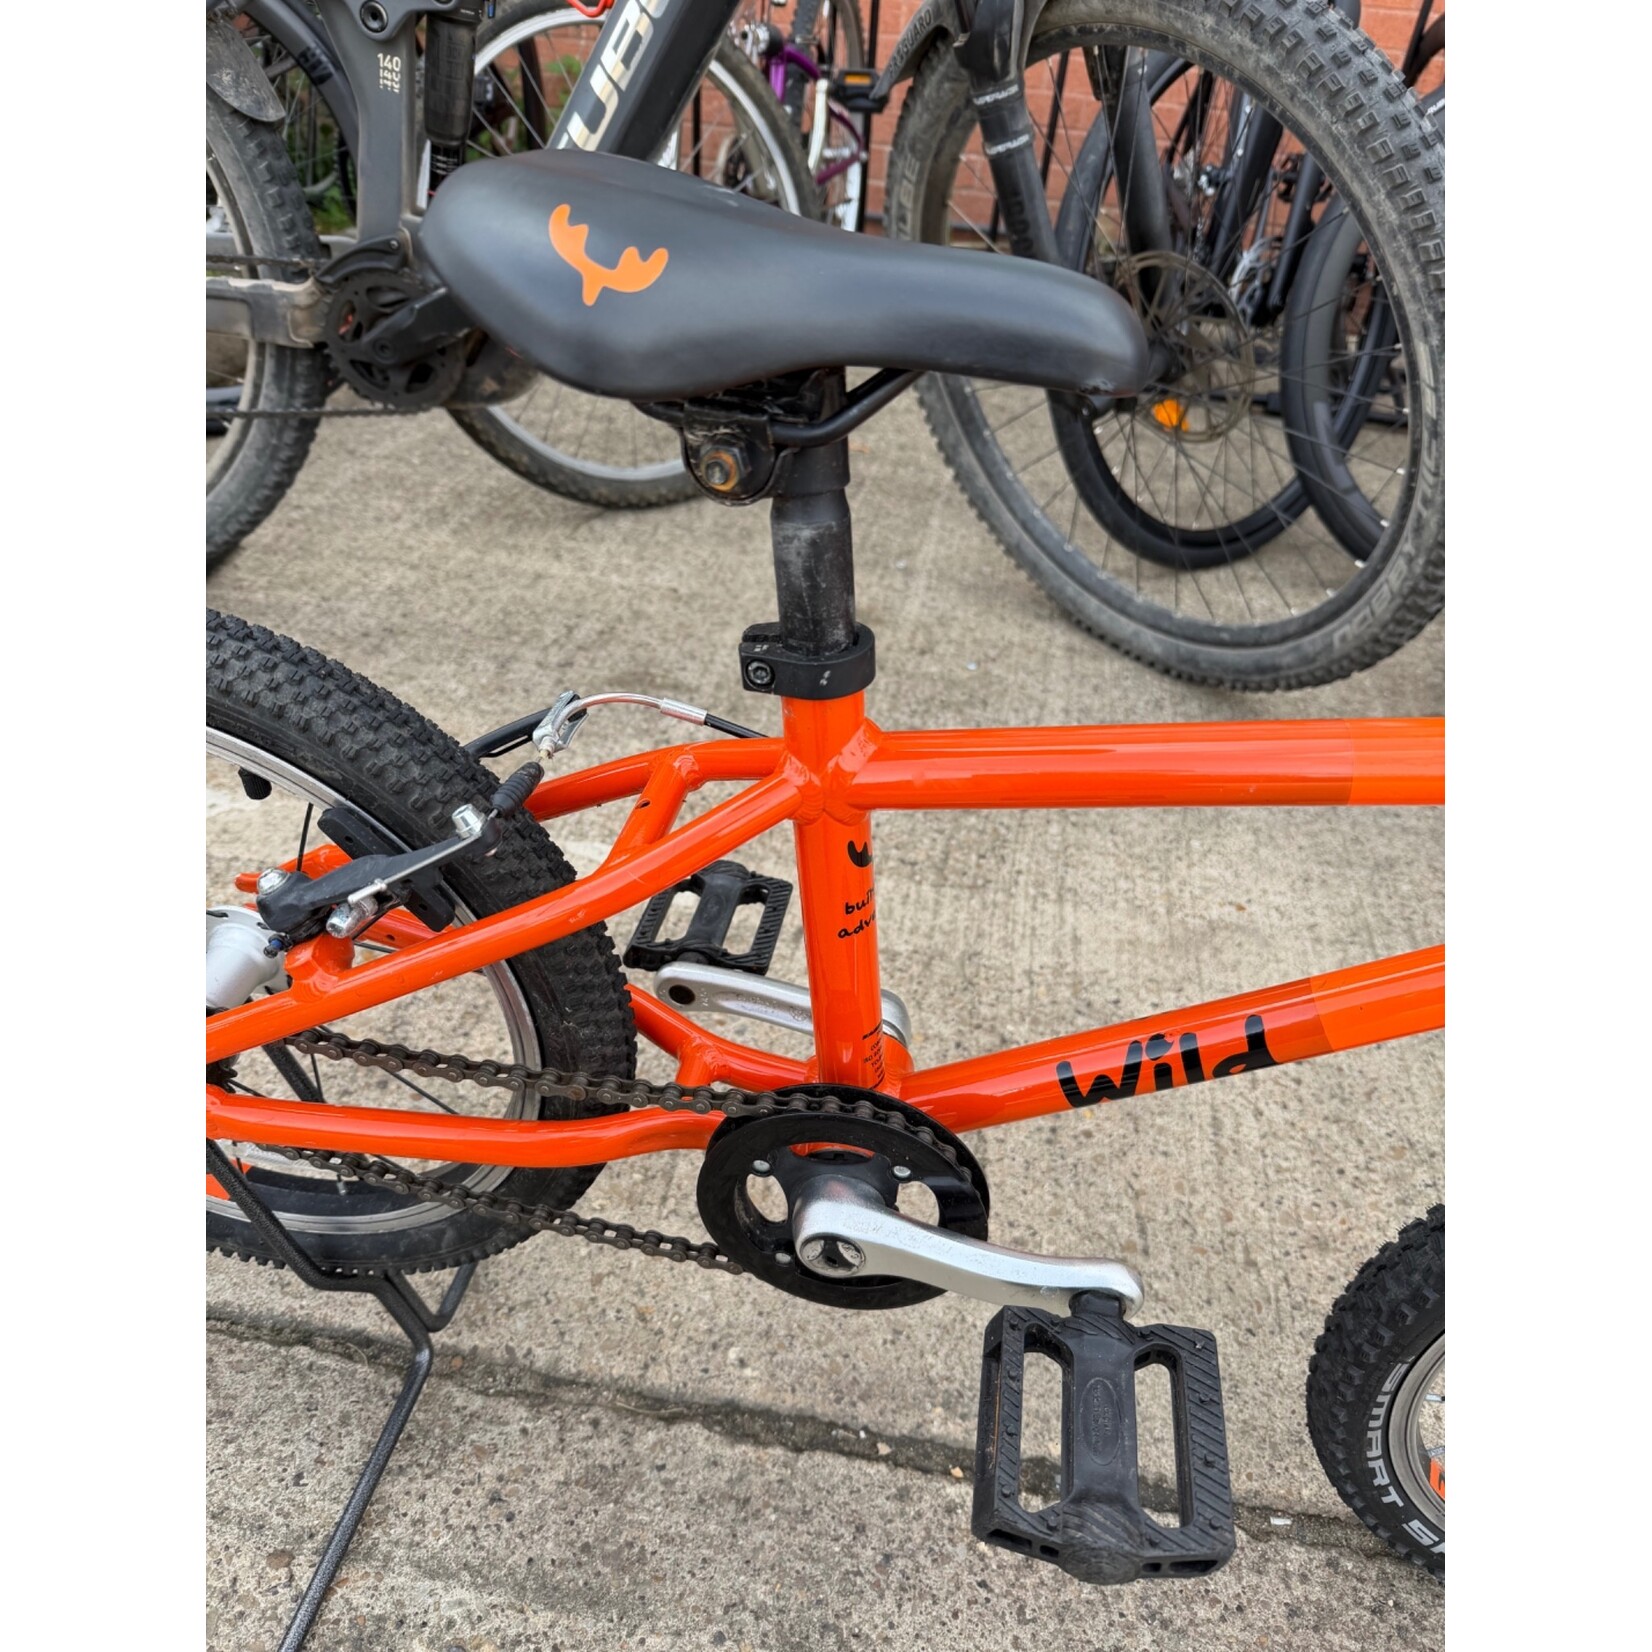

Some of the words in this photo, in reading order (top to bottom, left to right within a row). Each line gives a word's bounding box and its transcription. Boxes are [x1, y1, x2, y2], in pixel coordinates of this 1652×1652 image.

[377, 53, 402, 72] 140
[557, 0, 670, 152] UB
[1056, 1014, 1279, 1108] Wild
[1366, 1362, 1408, 1508] SMART
